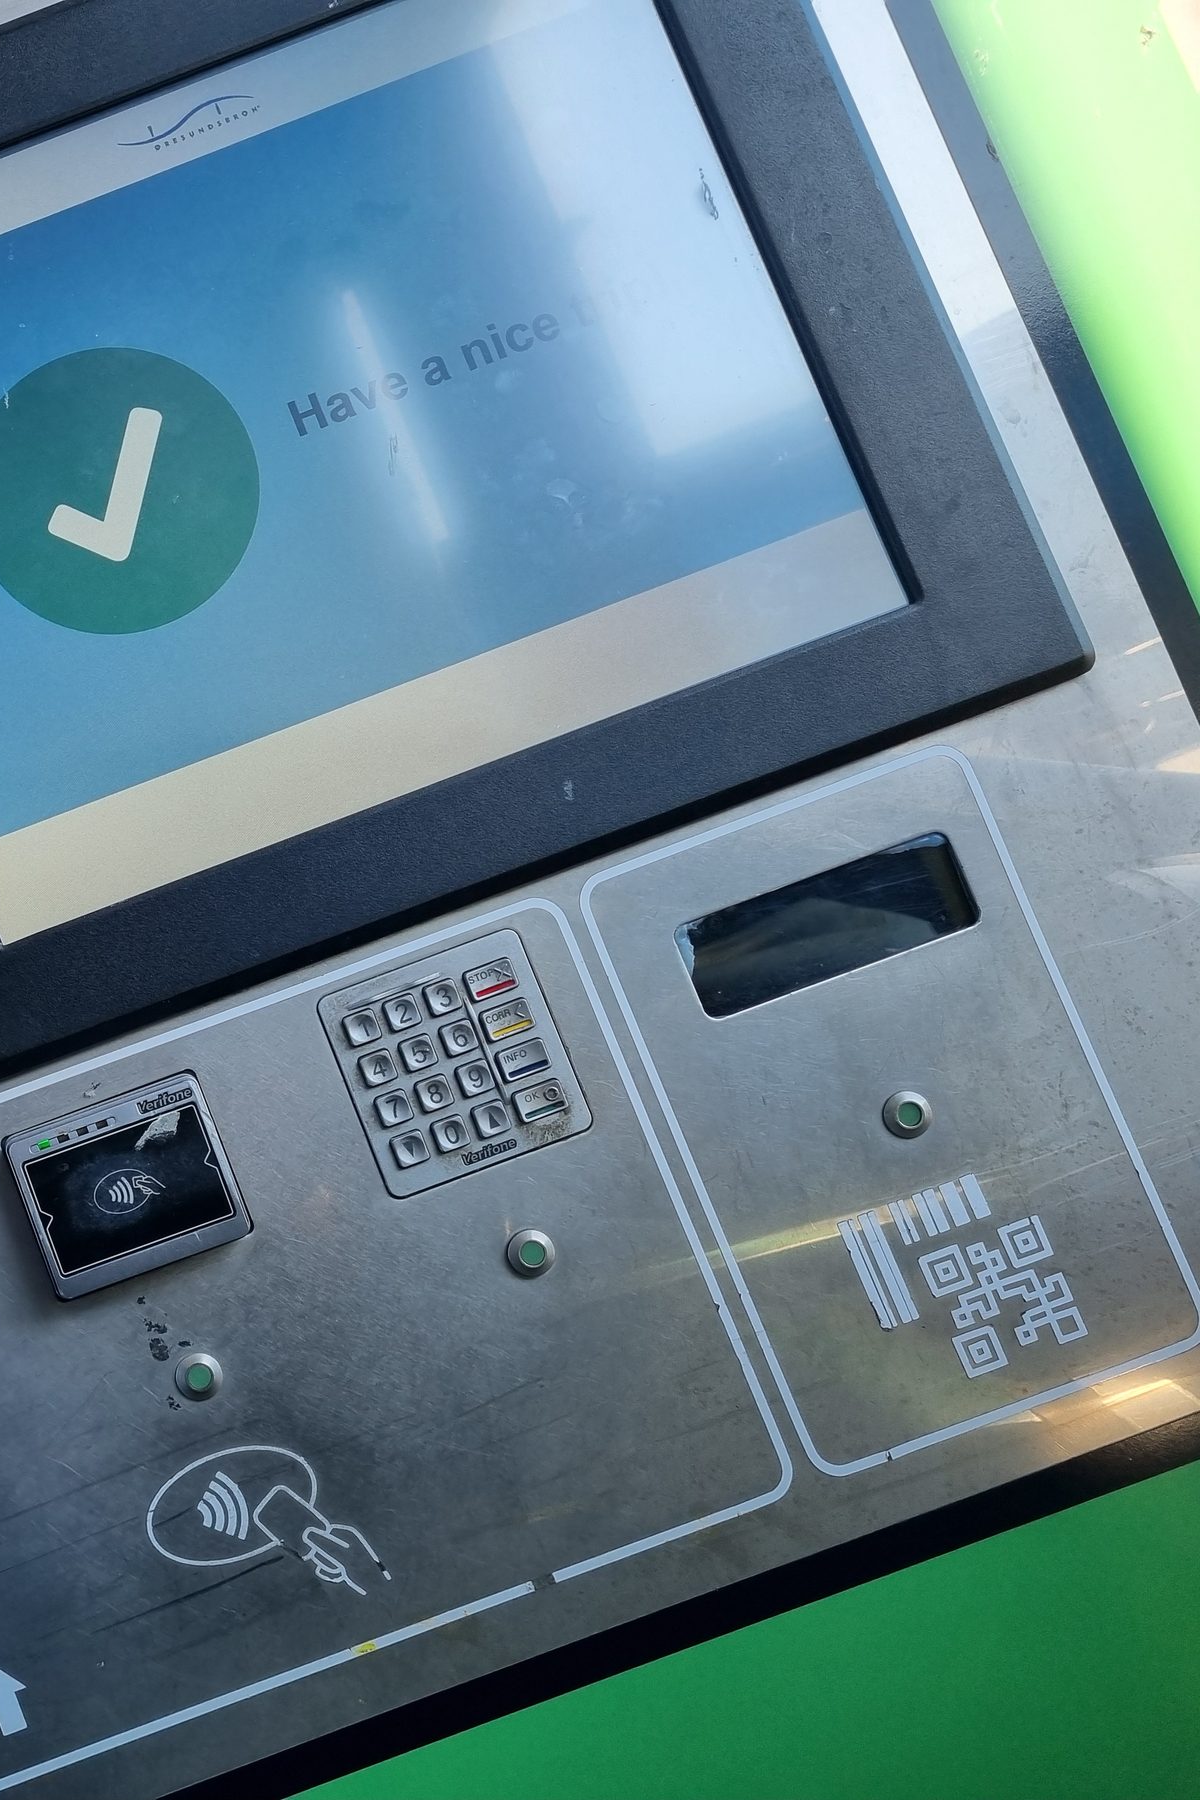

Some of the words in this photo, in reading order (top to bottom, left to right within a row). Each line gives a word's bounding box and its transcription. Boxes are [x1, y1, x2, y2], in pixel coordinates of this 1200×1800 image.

[287, 371, 409, 437] Have
[420, 355, 452, 386] a
[460, 312, 561, 372] nice
[468, 968, 495, 985] STOP
[435, 987, 452, 1007] 3
[395, 1003, 413, 1024] 2
[485, 1008, 512, 1024] CORR
[357, 1020, 373, 1037] 1
[452, 1027, 470, 1047] 6
[411, 1046, 429, 1064] 5
[503, 1049, 527, 1064] INFO
[372, 1061, 388, 1078] 4
[467, 1069, 484, 1088] 9
[137, 1087, 193, 1115] Verifone
[426, 1083, 444, 1104] 8
[524, 1091, 540, 1103] OK
[385, 1098, 400, 1118] 7
[444, 1125, 460, 1144] 0
[462, 1138, 518, 1166] Verifone
